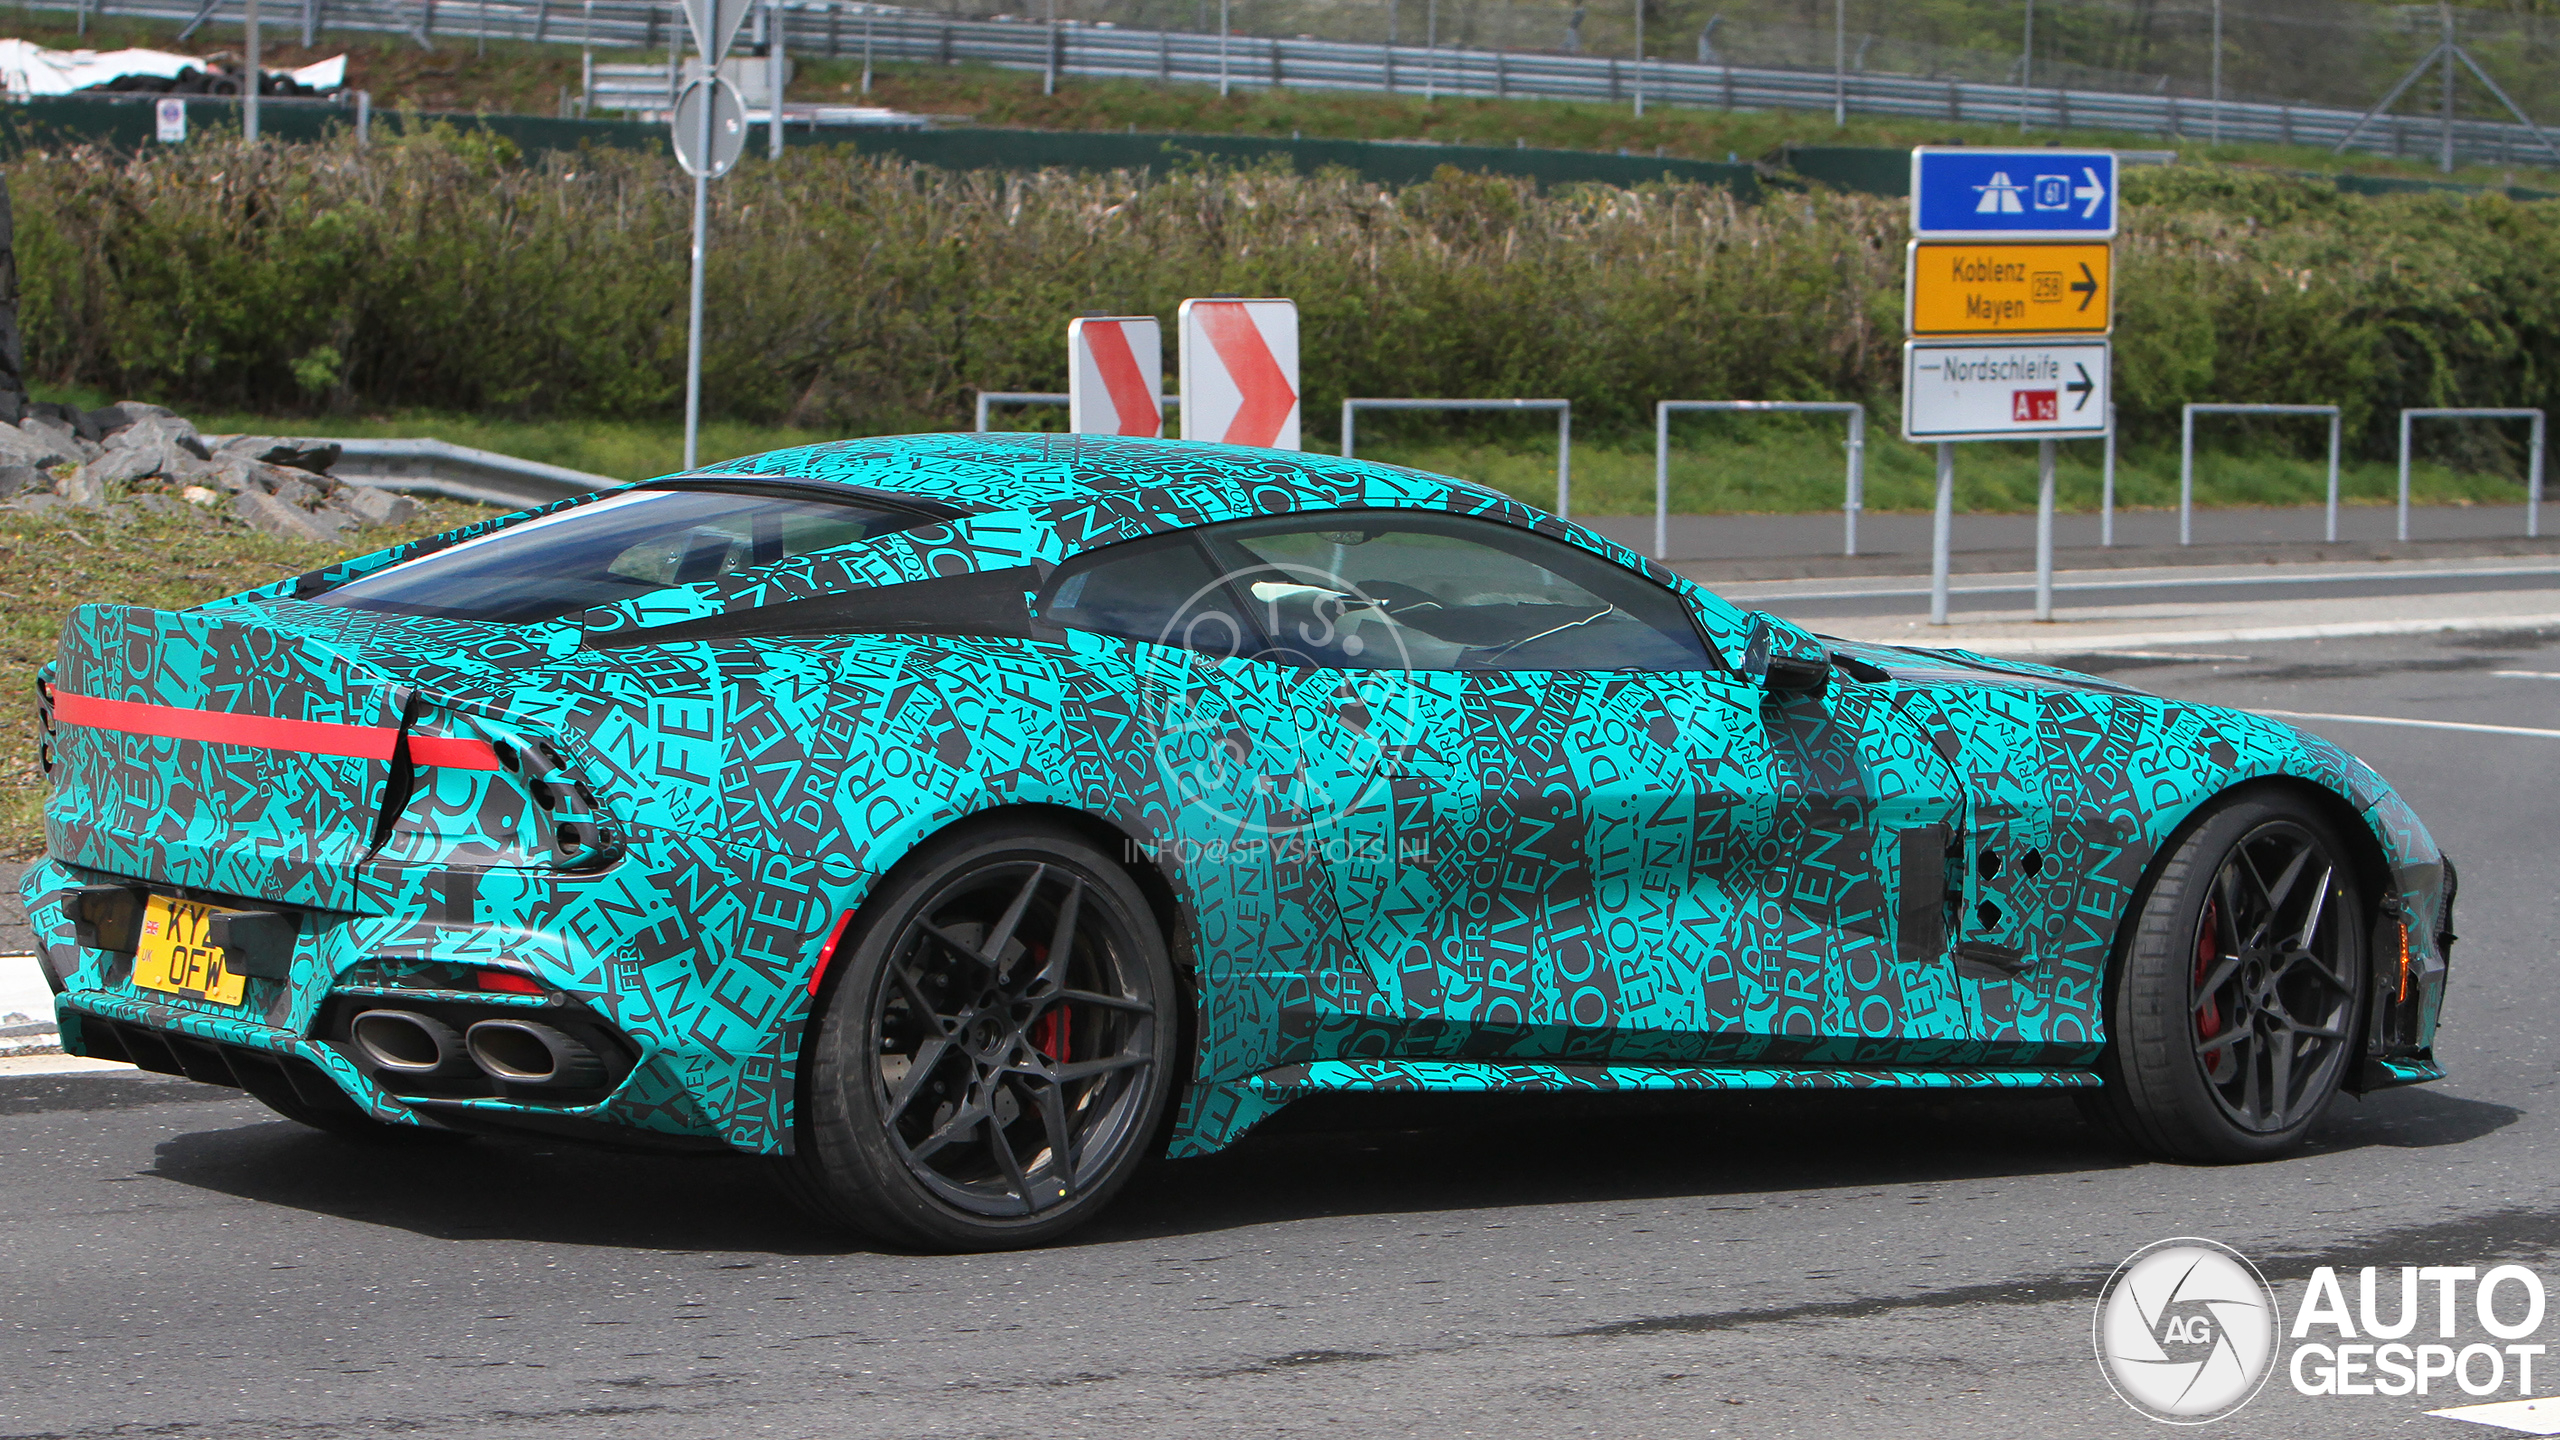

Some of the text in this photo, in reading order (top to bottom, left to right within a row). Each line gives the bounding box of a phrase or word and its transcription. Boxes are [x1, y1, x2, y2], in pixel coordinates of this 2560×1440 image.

[1951, 256, 2026, 282] Koblenz
[2035, 279, 2059, 297] 258
[1965, 295, 2025, 325] Mayen
[1943, 354, 2059, 381] Nordschleife
[2015, 395, 2030, 418] A
[142, 949, 153, 963] UK
